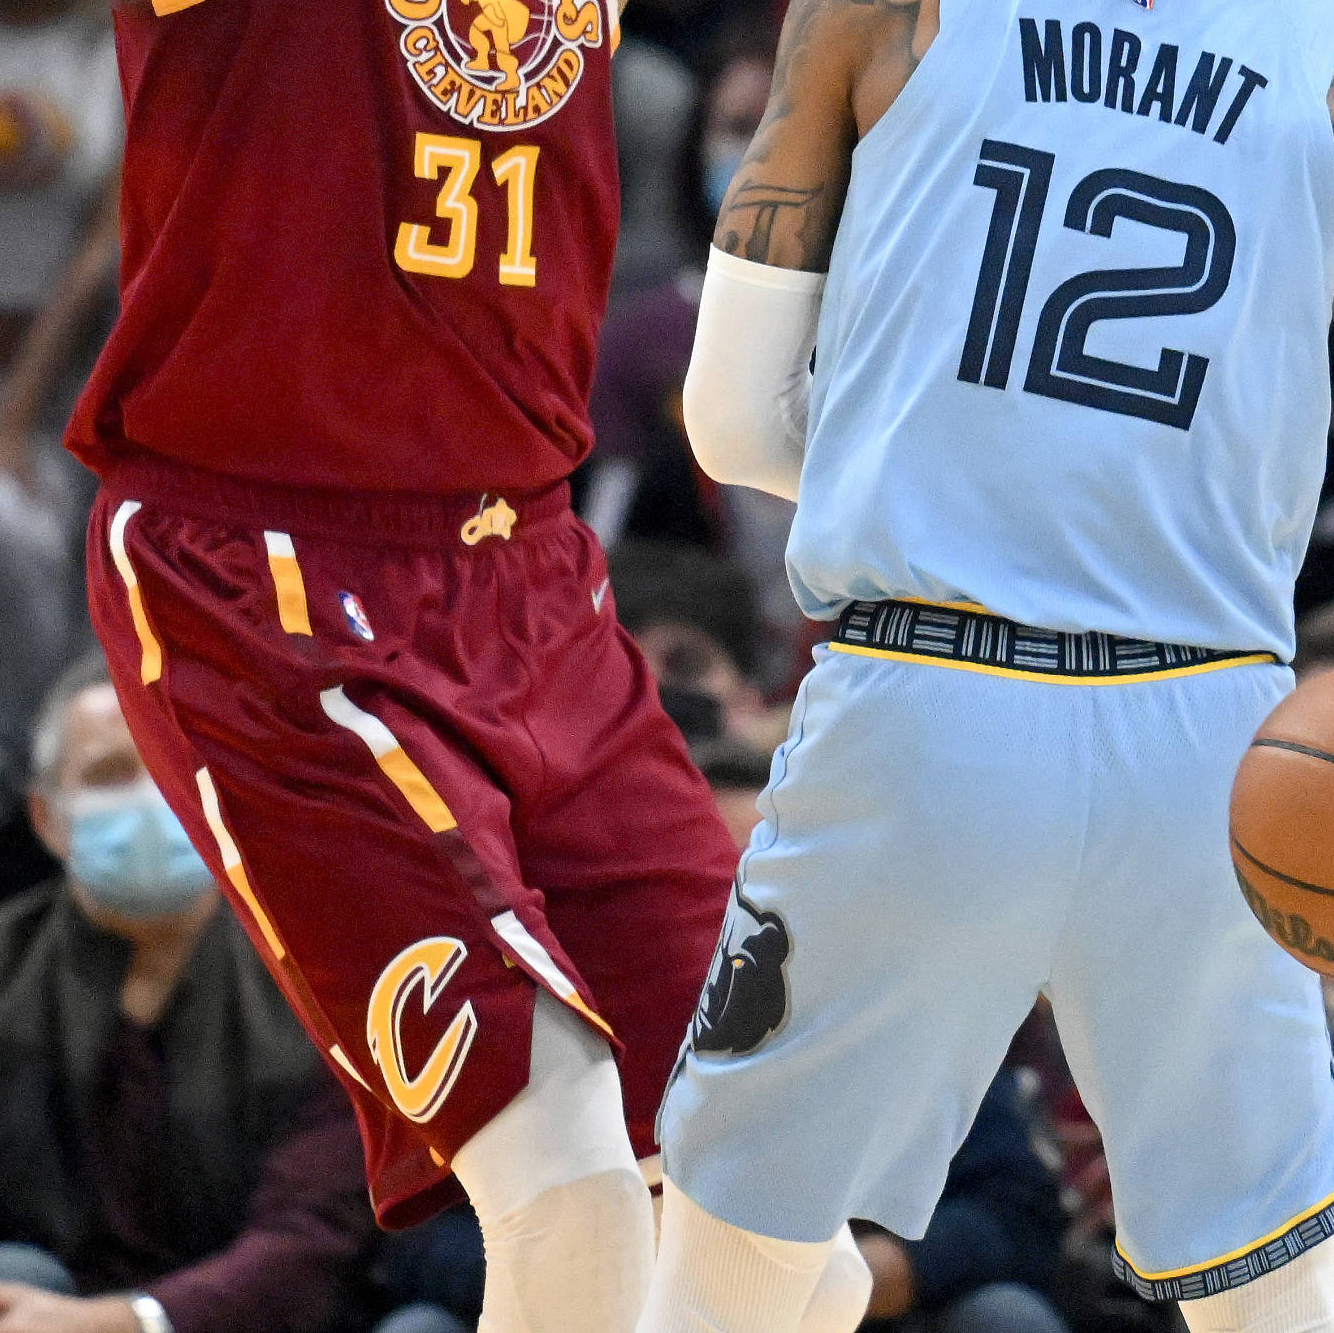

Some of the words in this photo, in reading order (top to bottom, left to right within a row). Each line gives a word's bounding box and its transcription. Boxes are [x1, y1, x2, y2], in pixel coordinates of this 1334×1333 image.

[405, 26, 581, 126] CLEVELAND
[1019, 17, 1268, 145] MORANT
[394, 131, 540, 287] 31
[957, 138, 1236, 431] 12
